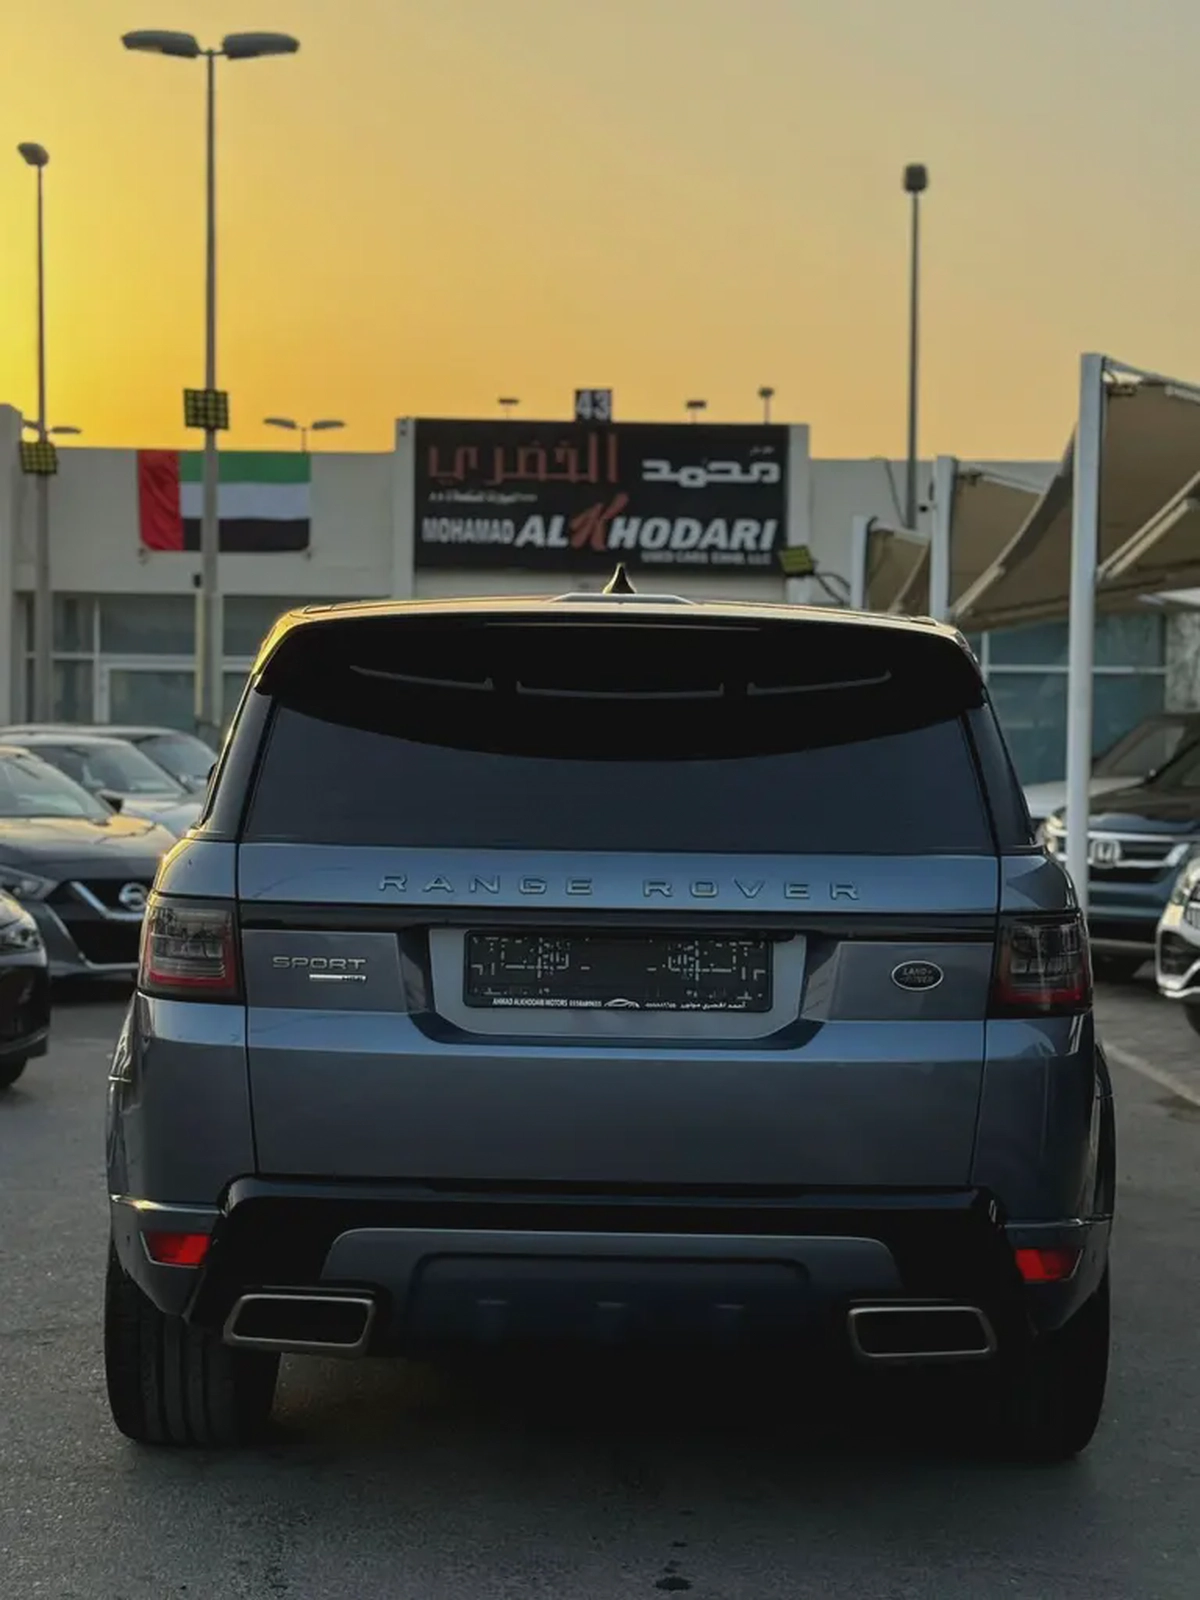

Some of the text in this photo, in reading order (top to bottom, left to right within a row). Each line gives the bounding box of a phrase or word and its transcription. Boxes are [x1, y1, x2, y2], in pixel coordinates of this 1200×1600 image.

[576, 391, 610, 421] 43
[641, 459, 781, 488] محمد
[422, 518, 515, 544] MOHAMAD
[378, 874, 859, 900] RANGE ROVER
[272, 956, 366, 970] SPORT
